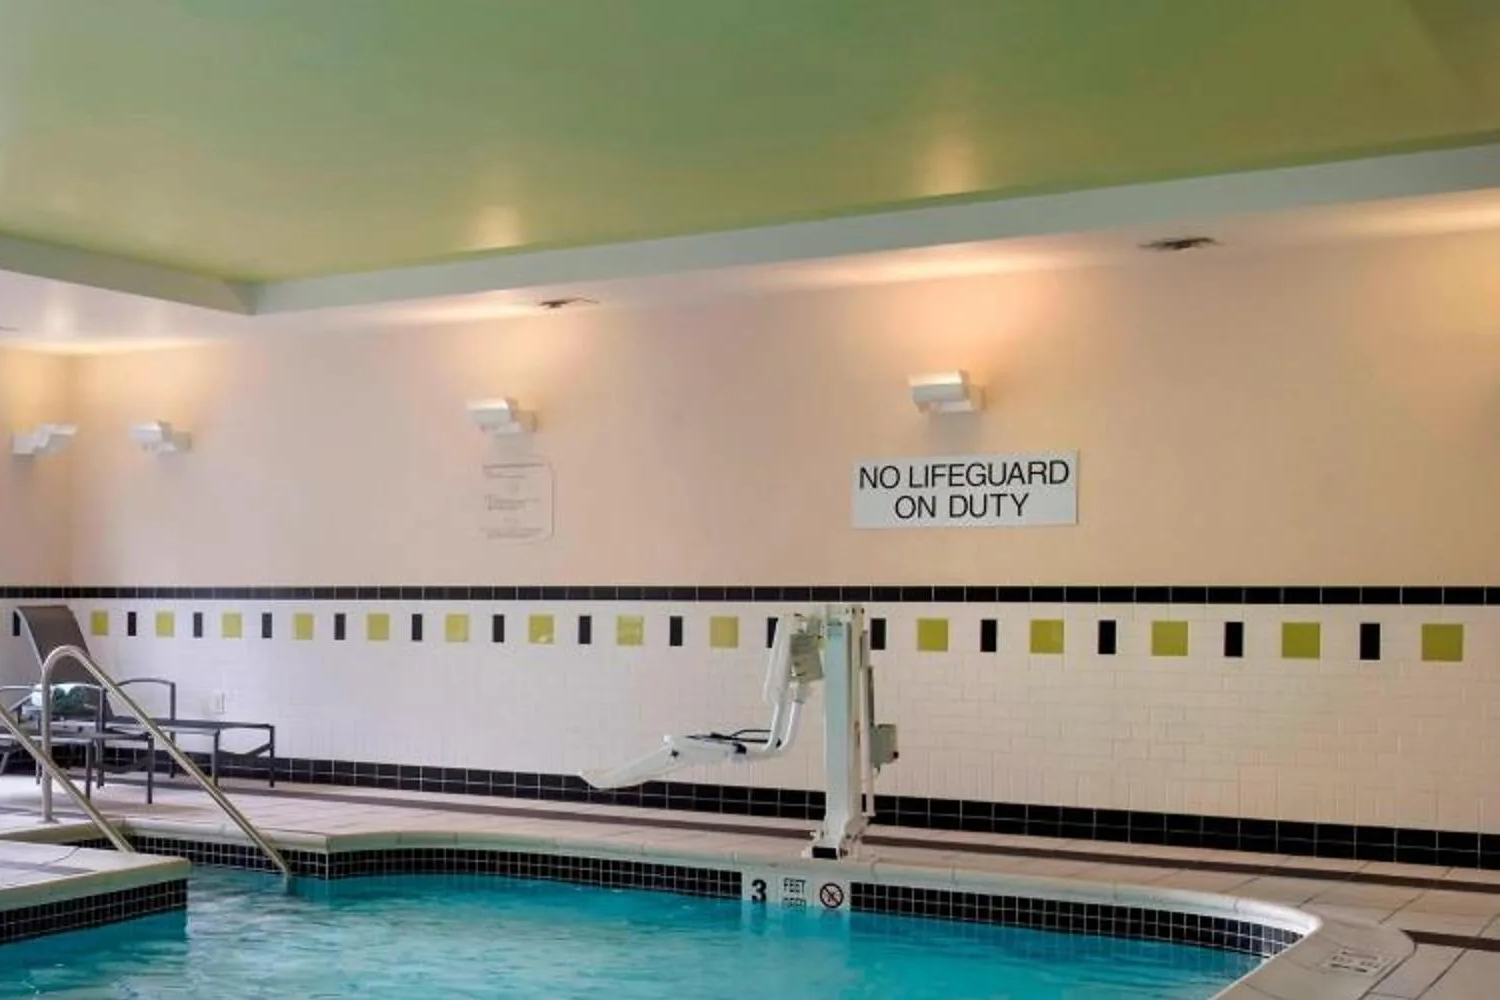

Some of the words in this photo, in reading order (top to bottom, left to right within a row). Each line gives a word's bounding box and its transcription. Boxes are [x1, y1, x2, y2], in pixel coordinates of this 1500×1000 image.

[859, 465, 901, 490] NO
[909, 459, 1070, 489] LIFEGUARD
[895, 495, 937, 519] ON
[949, 493, 1030, 518] DUTY
[752, 879, 767, 904] 3
[783, 877, 806, 894] FEET
